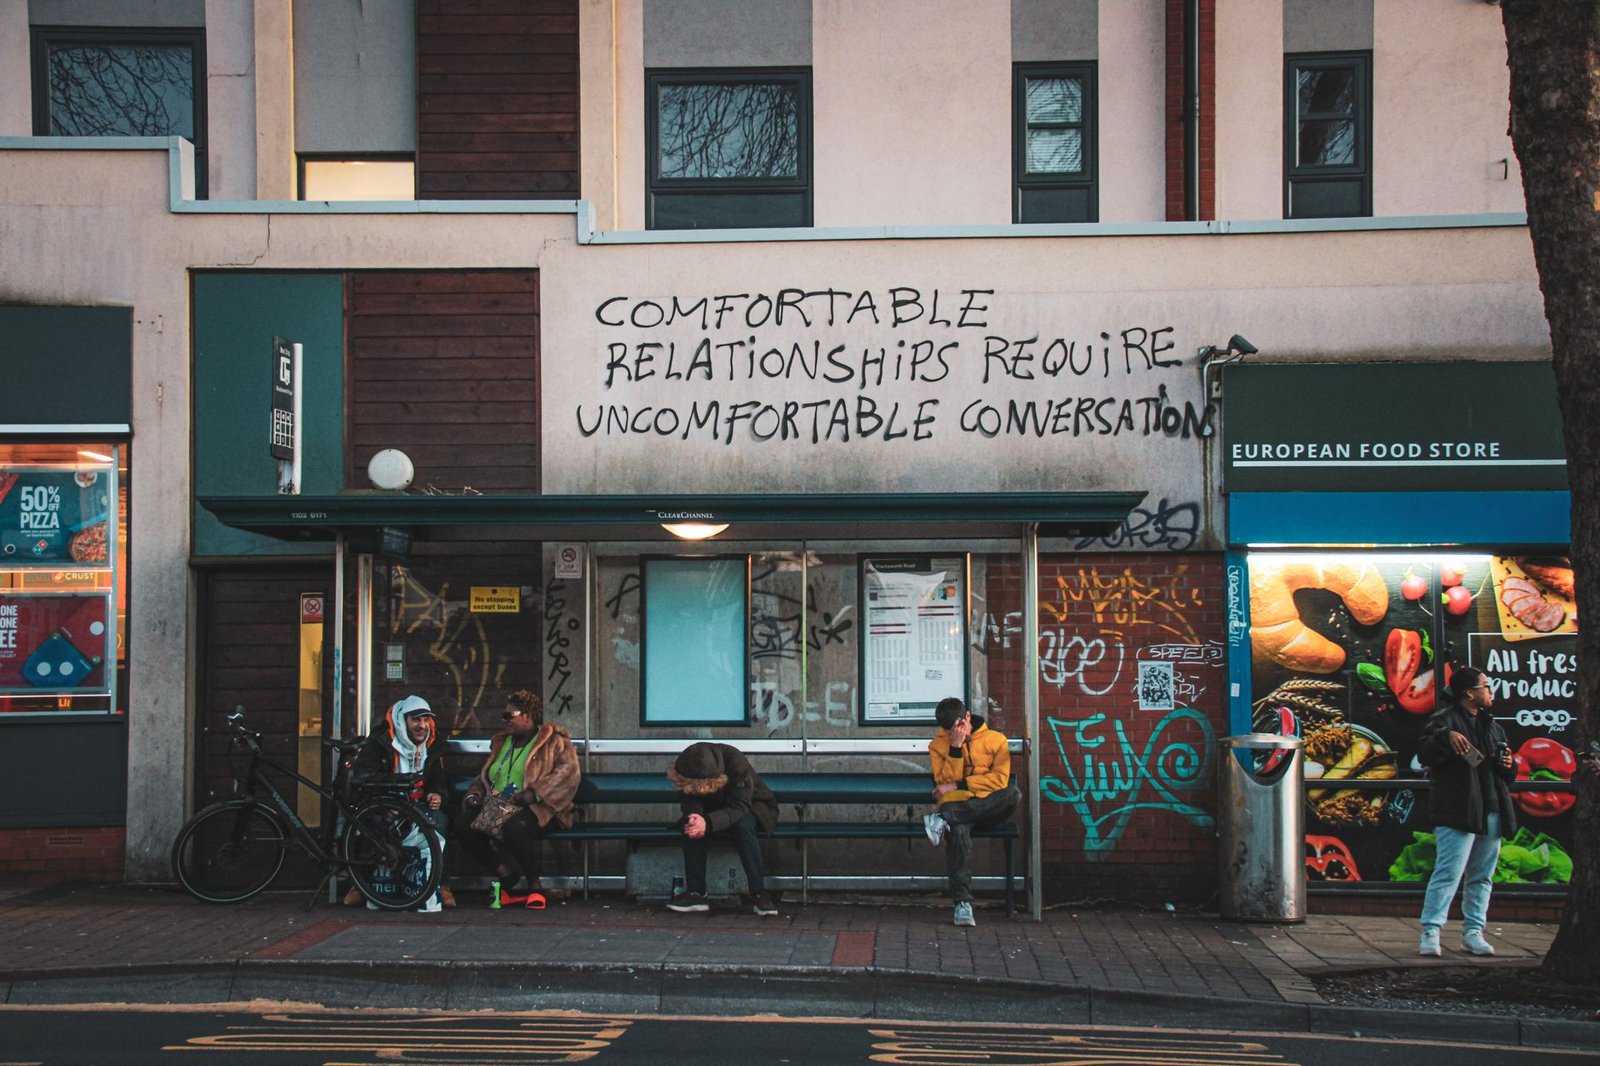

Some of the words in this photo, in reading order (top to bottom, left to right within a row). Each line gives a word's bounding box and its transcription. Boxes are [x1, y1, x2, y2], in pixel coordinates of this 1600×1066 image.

[595, 287, 994, 329] COMFORTABLE
[576, 394, 939, 445] UNCOMFORTABLE
[1232, 443, 1350, 459] EUROPEAN
[1359, 442, 1422, 458] FOOD
[1429, 442, 1500, 458] STORE
[20, 485, 60, 511] 50%
[48, 503, 60, 511] OFF
[20, 512, 60, 529] PIZZA
[65, 572, 95, 580] CRUST
[0, 605, 18, 616] ONE
[0, 617, 18, 628] ONE
[1486, 648, 1519, 673] All
[1487, 676, 1577, 701] produc
[1518, 711, 1569, 725] FOOD
